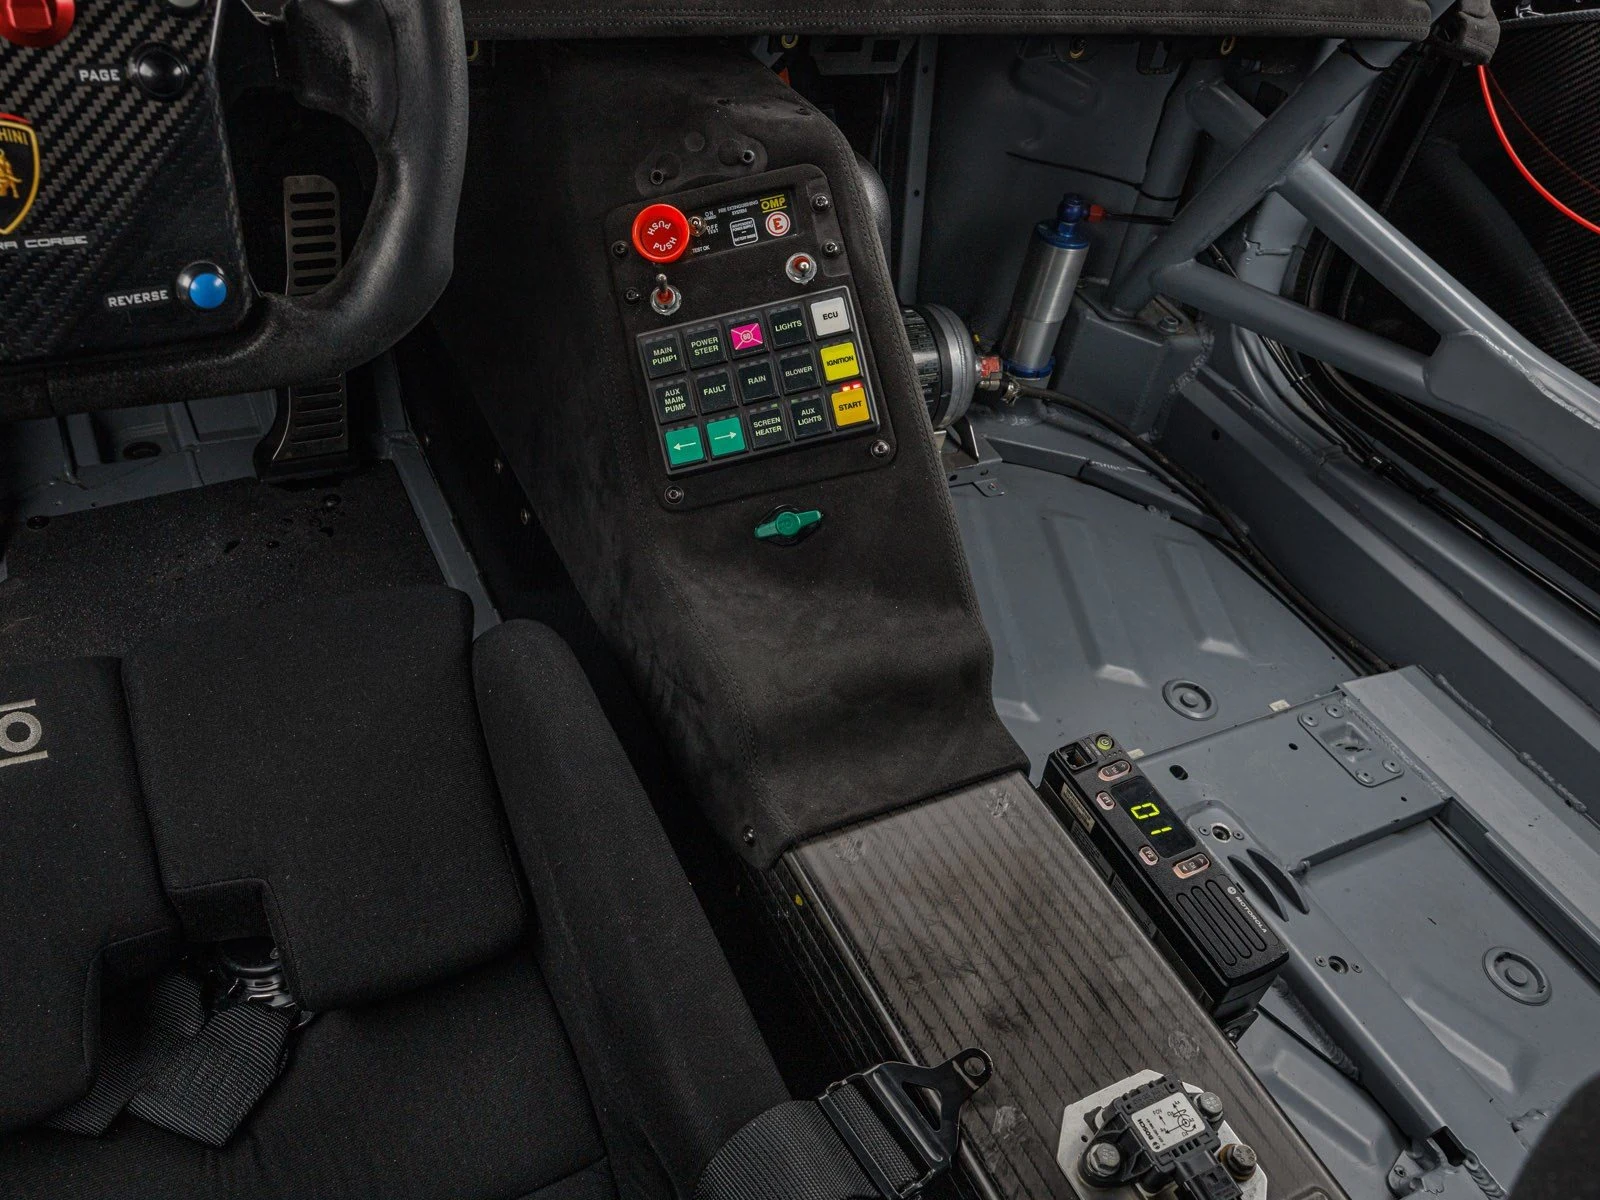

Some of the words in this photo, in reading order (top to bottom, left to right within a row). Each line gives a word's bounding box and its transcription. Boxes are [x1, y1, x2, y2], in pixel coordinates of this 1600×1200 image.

[80, 69, 120, 82] PAGE
[761, 197, 786, 210] OMP
[647, 220, 672, 236] PUSH
[772, 217, 783, 231] E
[24, 236, 88, 248] CORSE
[652, 236, 677, 252] PUSH
[108, 290, 168, 308] REVERSE
[822, 311, 838, 320] ECU
[775, 320, 802, 332] LIGHTS
[691, 336, 718, 348] POWER
[653, 347, 672, 356] MAIN
[694, 345, 719, 356] STEER
[652, 354, 677, 365] PUMP1
[826, 356, 854, 366] IGNITION
[785, 366, 812, 377] BLOWER
[748, 375, 766, 385] RAIN
[665, 388, 680, 397] AUX
[703, 384, 726, 396] FAULT
[664, 395, 684, 405] MAIN
[665, 403, 686, 414] PUMP
[838, 400, 862, 412] START
[801, 408, 816, 416] AUX
[753, 417, 780, 428] SCREEN
[798, 415, 822, 426] LIGHTS
[755, 425, 782, 436] HEATER
[1130, 802, 1173, 836] 01
[1236, 896, 1267, 933] MOTOROLA
[1138, 1118, 1154, 1140] BOSCH
